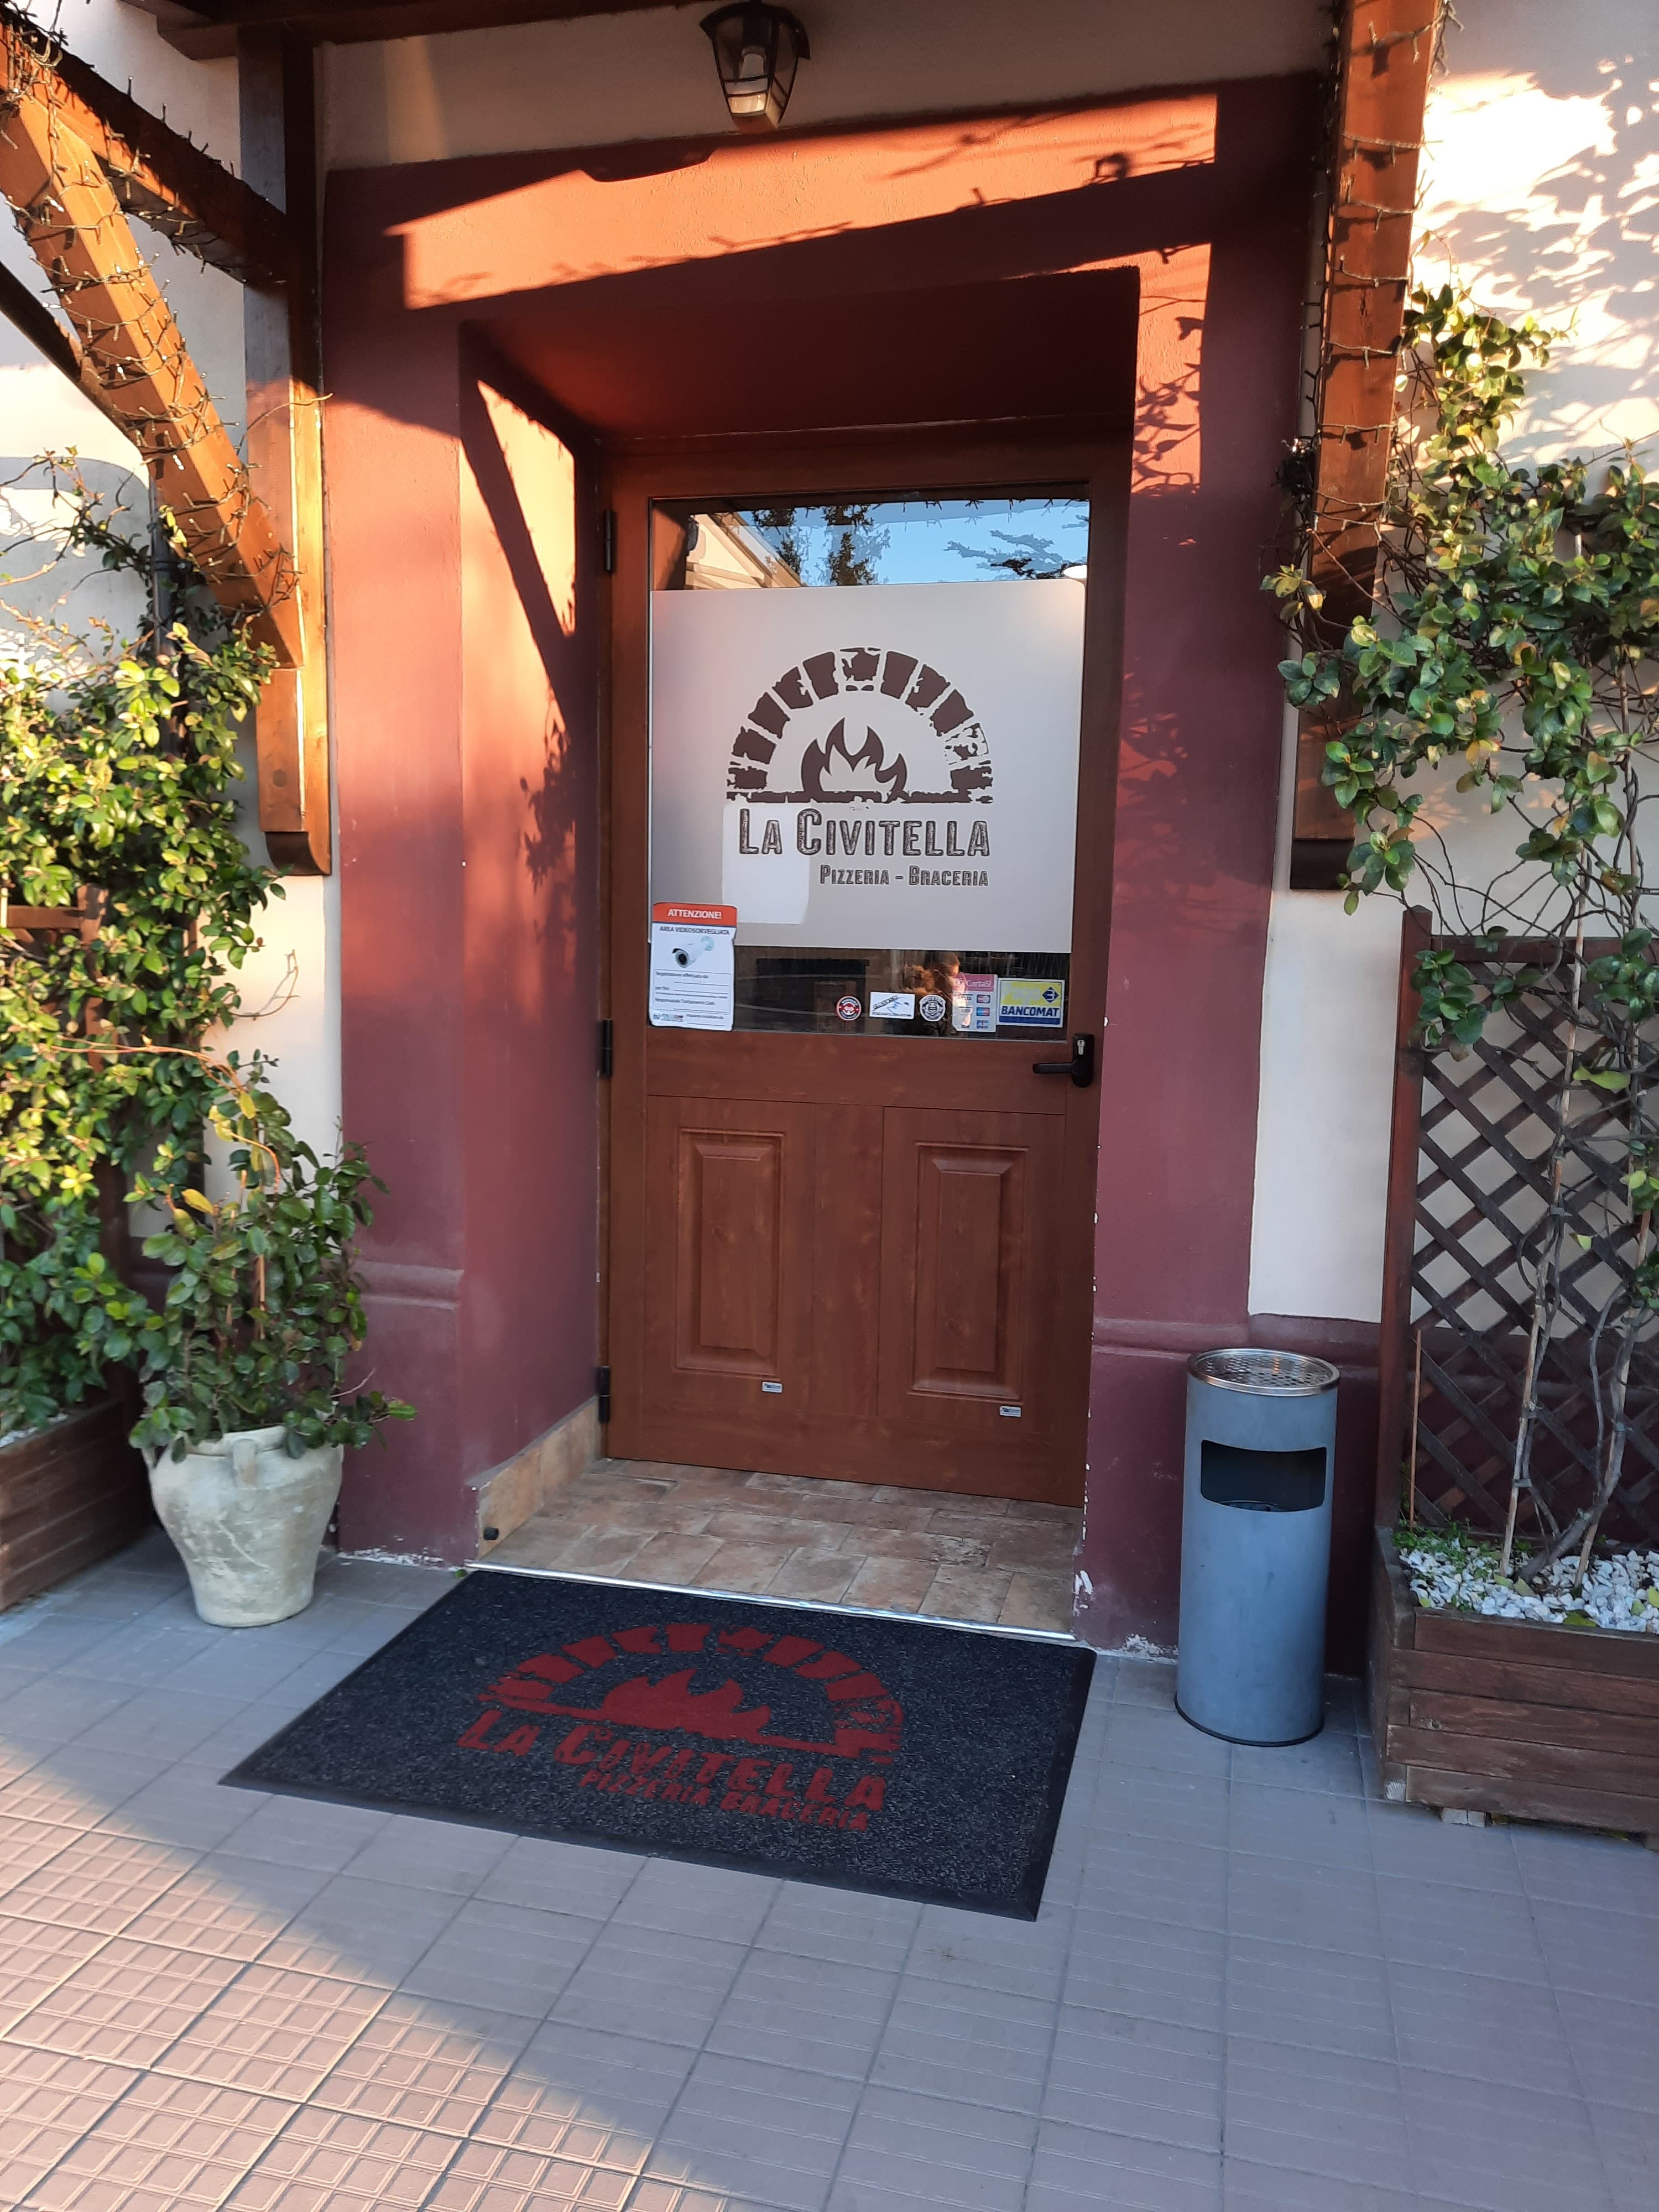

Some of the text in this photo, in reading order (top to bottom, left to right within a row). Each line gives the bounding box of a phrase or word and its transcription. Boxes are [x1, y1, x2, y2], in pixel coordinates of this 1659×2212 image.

[667, 909, 722, 919] ATTENZIONE!
[1001, 1005, 1060, 1017] BANCOMAT
[553, 1724, 887, 1811] CIVITELLA
[578, 1770, 869, 1832] PIZZERIA BRACERIA
